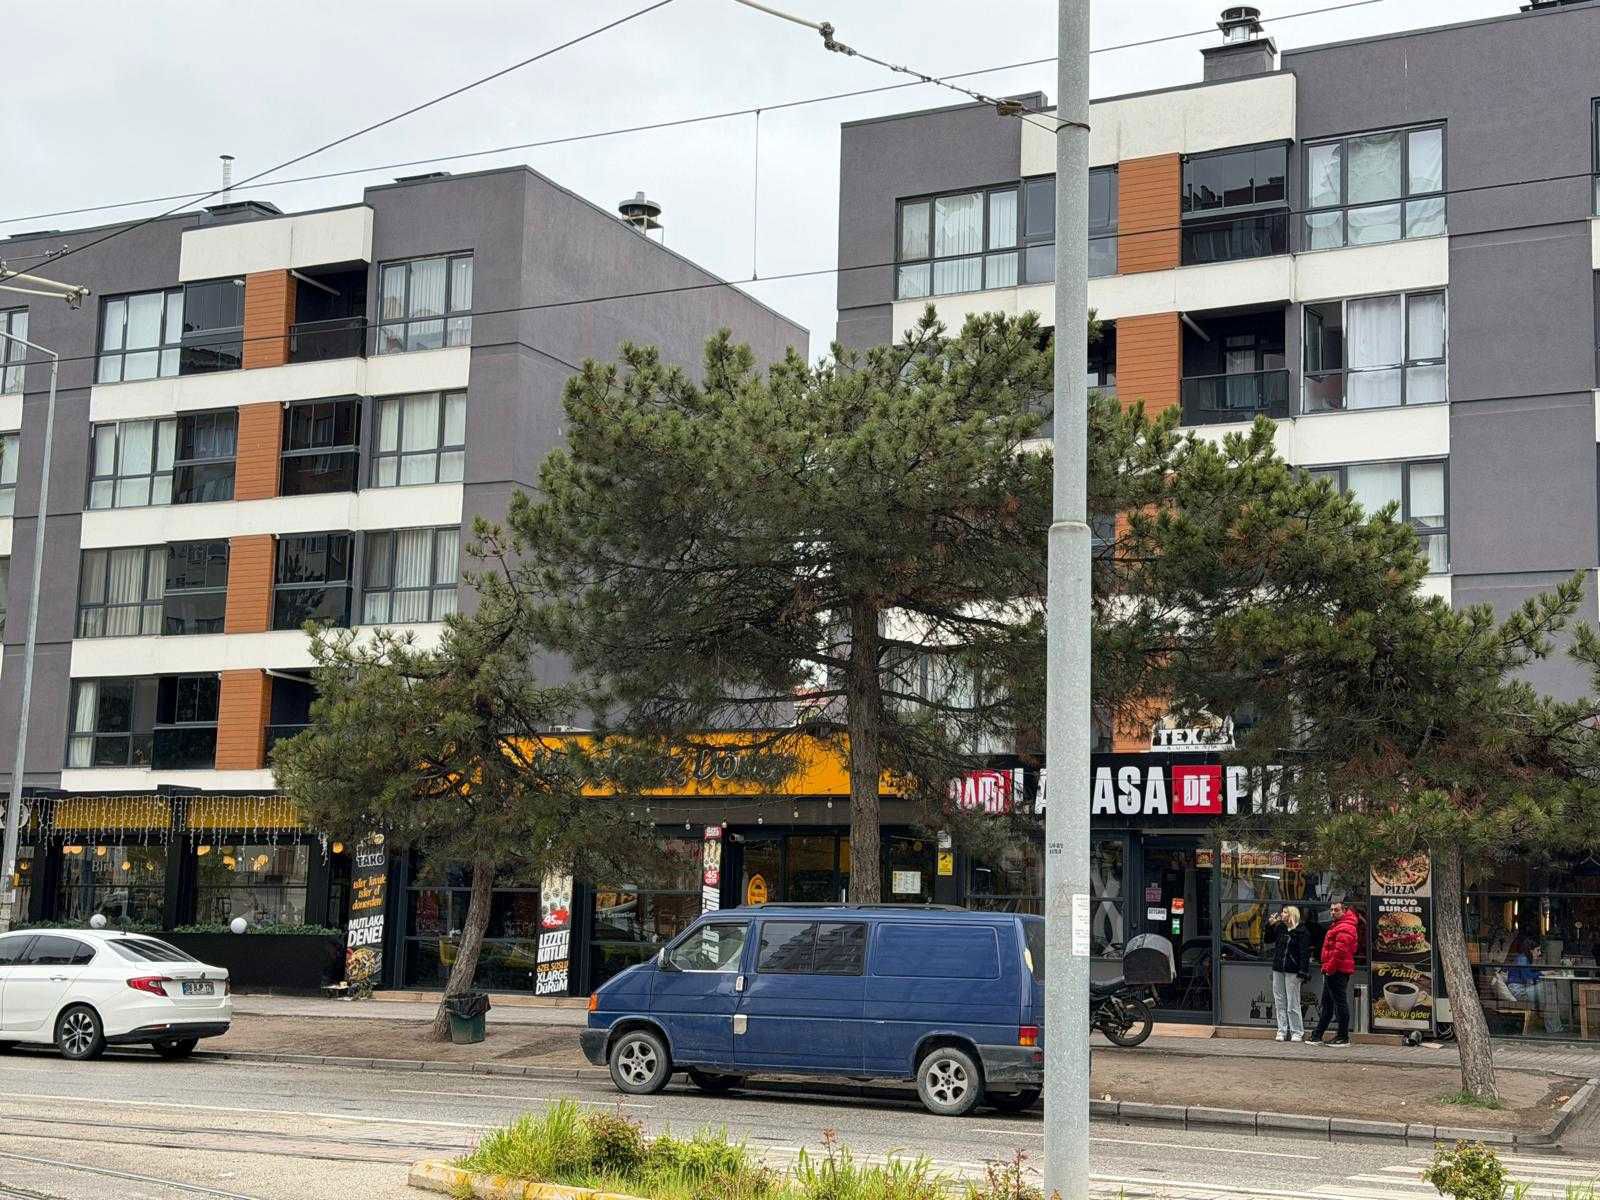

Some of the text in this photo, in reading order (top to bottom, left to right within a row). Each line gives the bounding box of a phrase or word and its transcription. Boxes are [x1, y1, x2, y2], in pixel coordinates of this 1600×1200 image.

[1092, 766, 1169, 816] ASA
[1183, 774, 1211, 807] DE
[1384, 885, 1417, 895] PIZZA
[348, 914, 385, 931] MUTLAKA
[347, 929, 383, 948] DENE!
[536, 969, 569, 983] XLARGE
